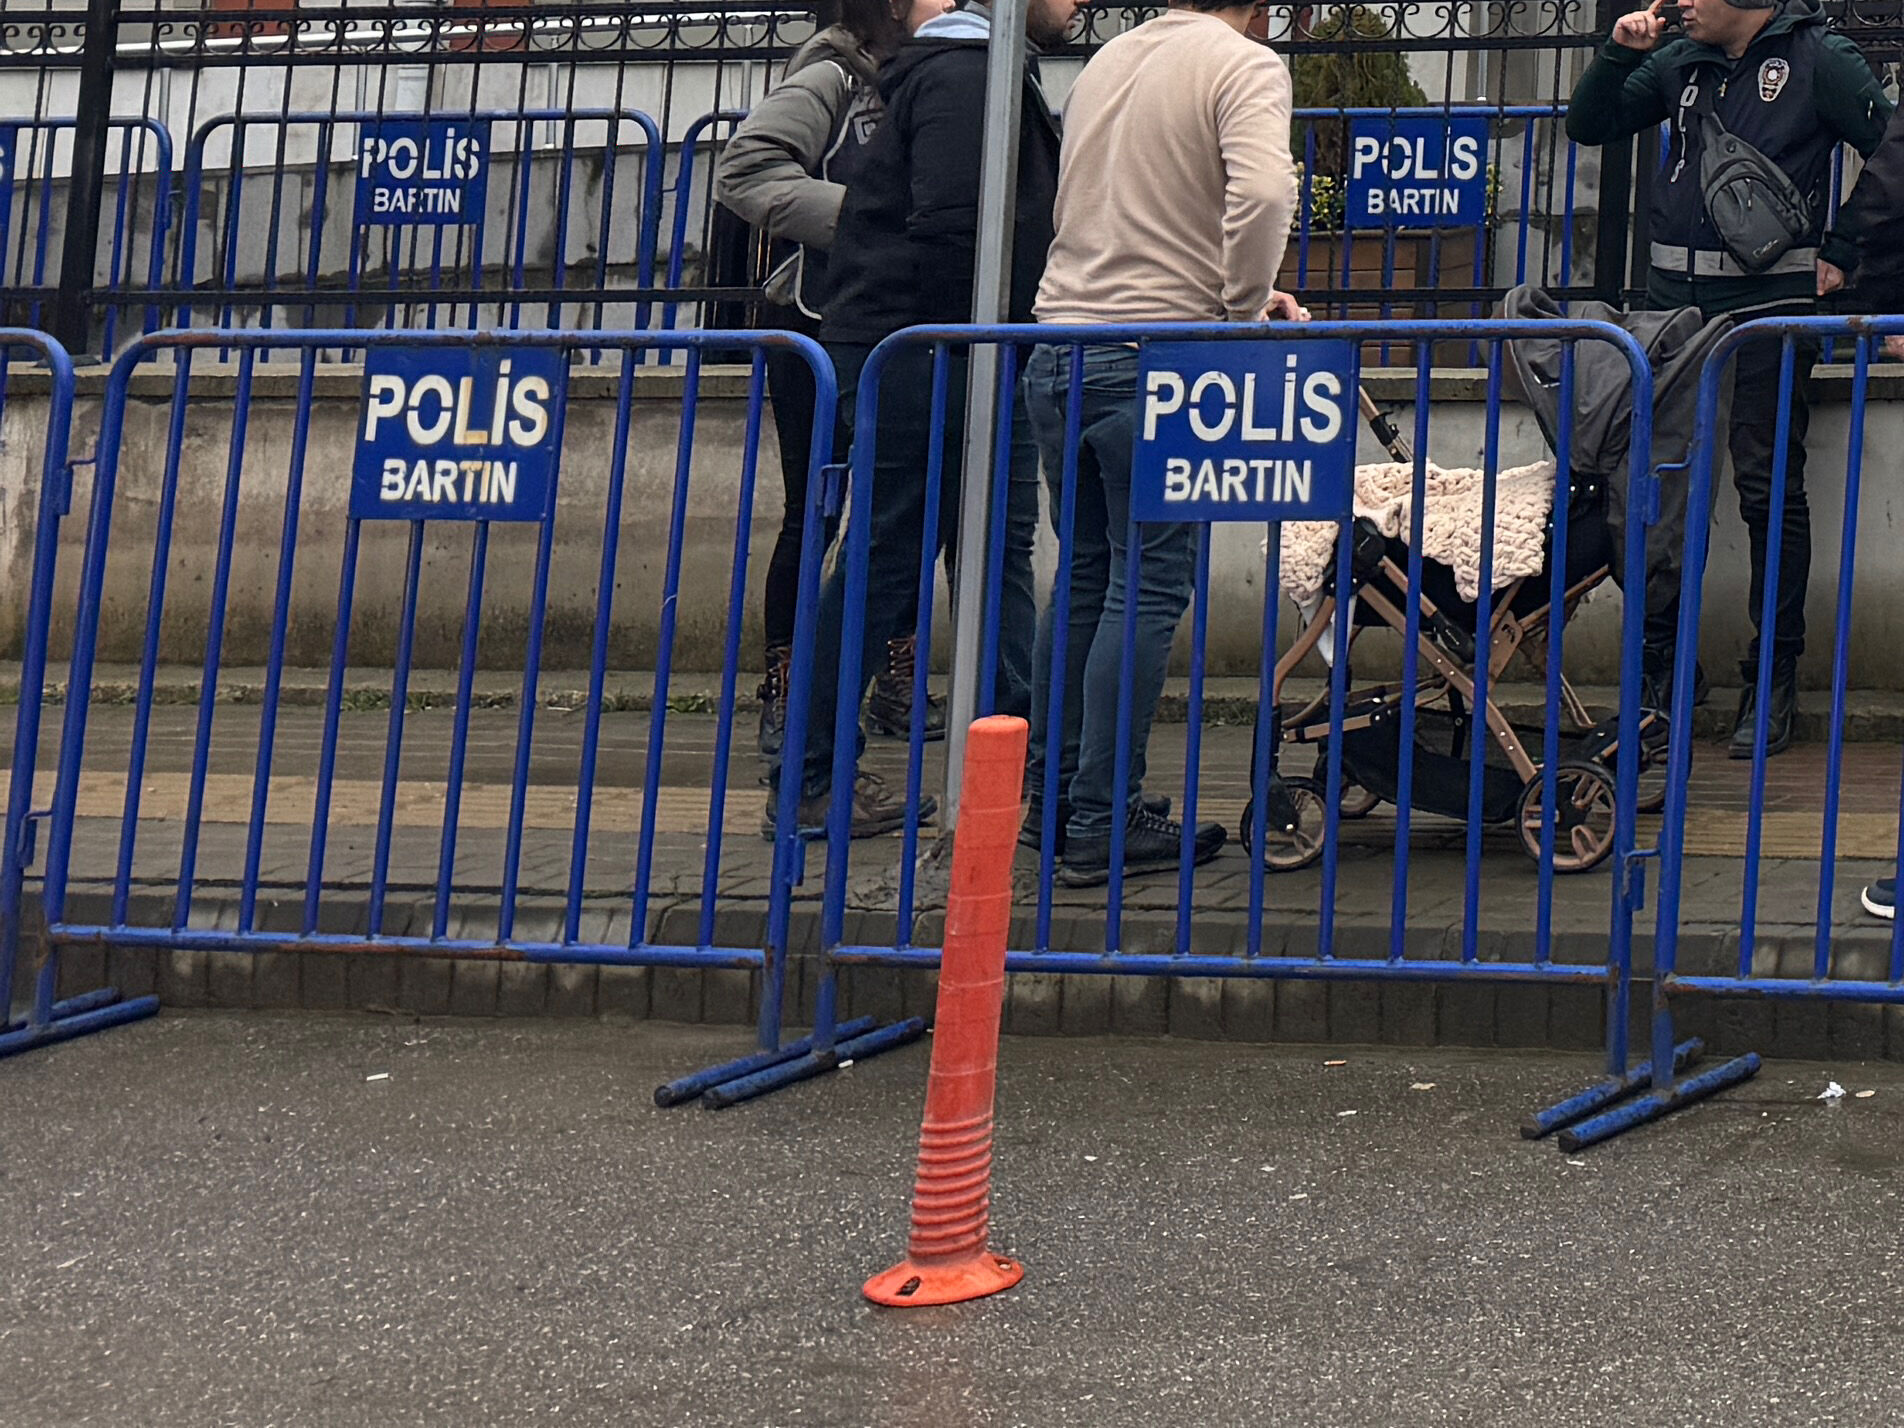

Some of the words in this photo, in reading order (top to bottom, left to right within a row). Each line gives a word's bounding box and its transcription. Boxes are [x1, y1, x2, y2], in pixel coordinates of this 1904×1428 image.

[362, 127, 480, 179] POLİS
[374, 188, 460, 213] BARTIN
[1367, 188, 1459, 214] BARTIN
[365, 359, 549, 447] POLİS
[1143, 354, 1342, 444] POLİS
[380, 458, 517, 504] BARTIN
[1164, 457, 1312, 503] BARTIN
